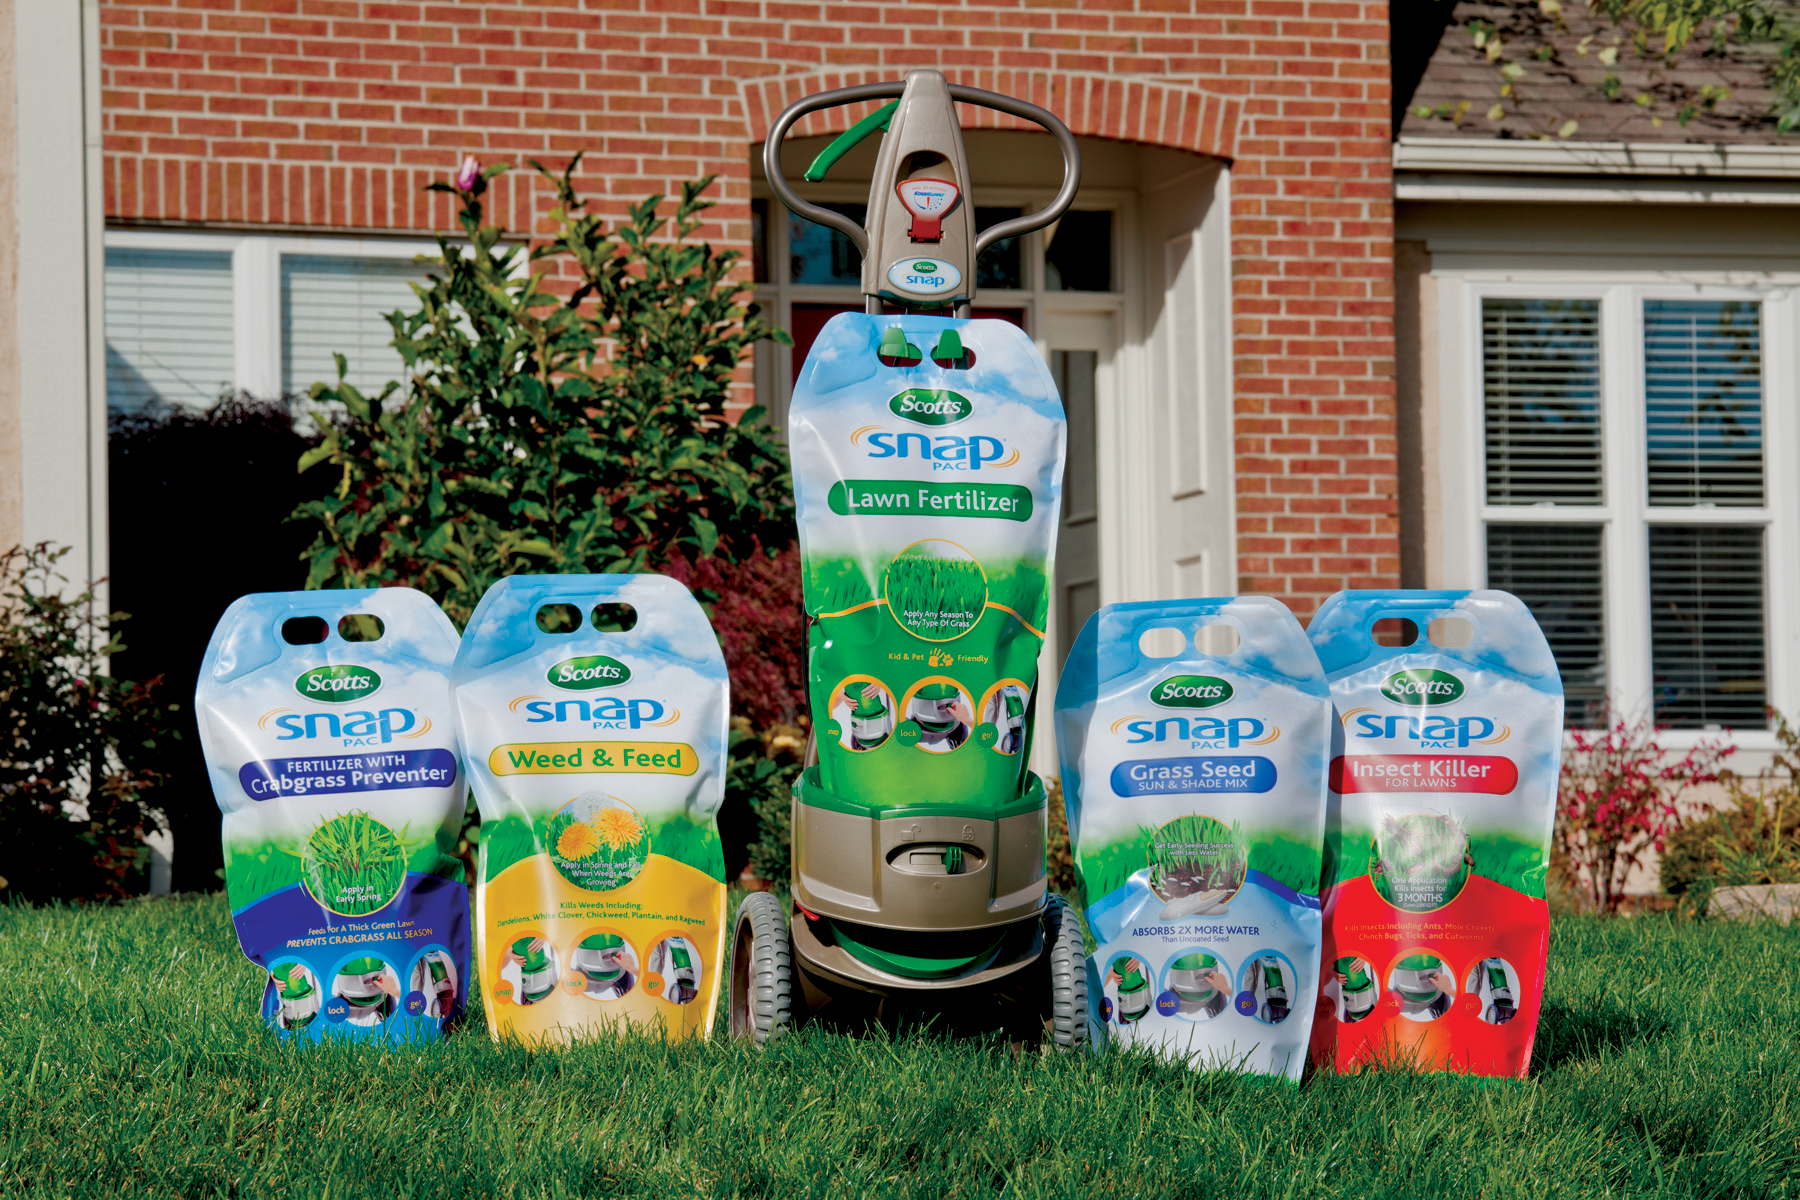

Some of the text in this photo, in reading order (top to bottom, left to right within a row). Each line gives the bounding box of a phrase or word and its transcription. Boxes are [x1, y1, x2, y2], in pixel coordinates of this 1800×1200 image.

[906, 276, 945, 287] snap
[899, 395, 962, 414] Scotts
[867, 433, 1004, 470] snap
[933, 461, 967, 471] PAC
[849, 488, 1018, 513] Lawn Fertilizer
[903, 610, 923, 619] Apply
[924, 611, 938, 619] Any
[940, 611, 963, 619] Season
[907, 619, 921, 627] Any
[922, 619, 938, 628] Type
[950, 620, 970, 628] Grass
[912, 653, 924, 661] Pet
[958, 655, 989, 664] Friendly
[558, 665, 621, 682] Scotts
[306, 675, 370, 692] Scotts
[1391, 678, 1454, 695] Scotts
[1160, 683, 1223, 700] Scotts
[526, 697, 664, 729] snap
[275, 707, 415, 744] snap
[593, 721, 627, 729] PAC
[901, 729, 917, 737] lock
[981, 731, 992, 740] go!
[1127, 717, 1264, 748] snap
[1356, 714, 1494, 748] snap
[344, 737, 379, 747] PAC
[1192, 741, 1225, 749] PAC
[287, 754, 405, 773] FERTILIZER WITH
[508, 748, 681, 768] Weed & Feed
[1130, 760, 1256, 781] Grass Seed
[1353, 760, 1491, 778] Insect Killer
[251, 766, 448, 793] Crabgrass Preventer
[1139, 779, 1248, 791] SUN & SHADE MIX
[1385, 778, 1456, 787] FOR LAWNS
[561, 861, 580, 869] Apply
[591, 861, 612, 870] Spring
[586, 878, 616, 887] Growing
[1408, 877, 1447, 885] Application
[342, 885, 364, 893] Apply
[336, 892, 381, 903] Early Spring
[1398, 894, 1443, 902] 3 MONTHS
[606, 902, 643, 910] Including:
[497, 915, 532, 927] Dandelions,
[533, 912, 556, 920] White
[586, 911, 630, 919] Chickweed,
[632, 912, 664, 920] Plantain,
[679, 915, 706, 926] Ragweed
[308, 927, 326, 936] Feeds
[327, 926, 339, 934] For
[349, 923, 369, 931] Thick
[371, 922, 395, 930] Green
[397, 920, 415, 928] Lawn
[1132, 926, 1259, 937] ABSORBS 2X MORE WATER
[1387, 923, 1422, 931] Including
[286, 928, 433, 948] PREVENTS CRABGRASS ALL SEASON
[1385, 933, 1404, 941] Bugs,
[1406, 931, 1427, 940] Ticks,
[566, 979, 582, 987] lock
[648, 981, 659, 989] go!
[496, 989, 511, 997] snap
[1160, 1000, 1176, 1008] lock
[1241, 1000, 1253, 1009] go!
[328, 1006, 345, 1015] lock
